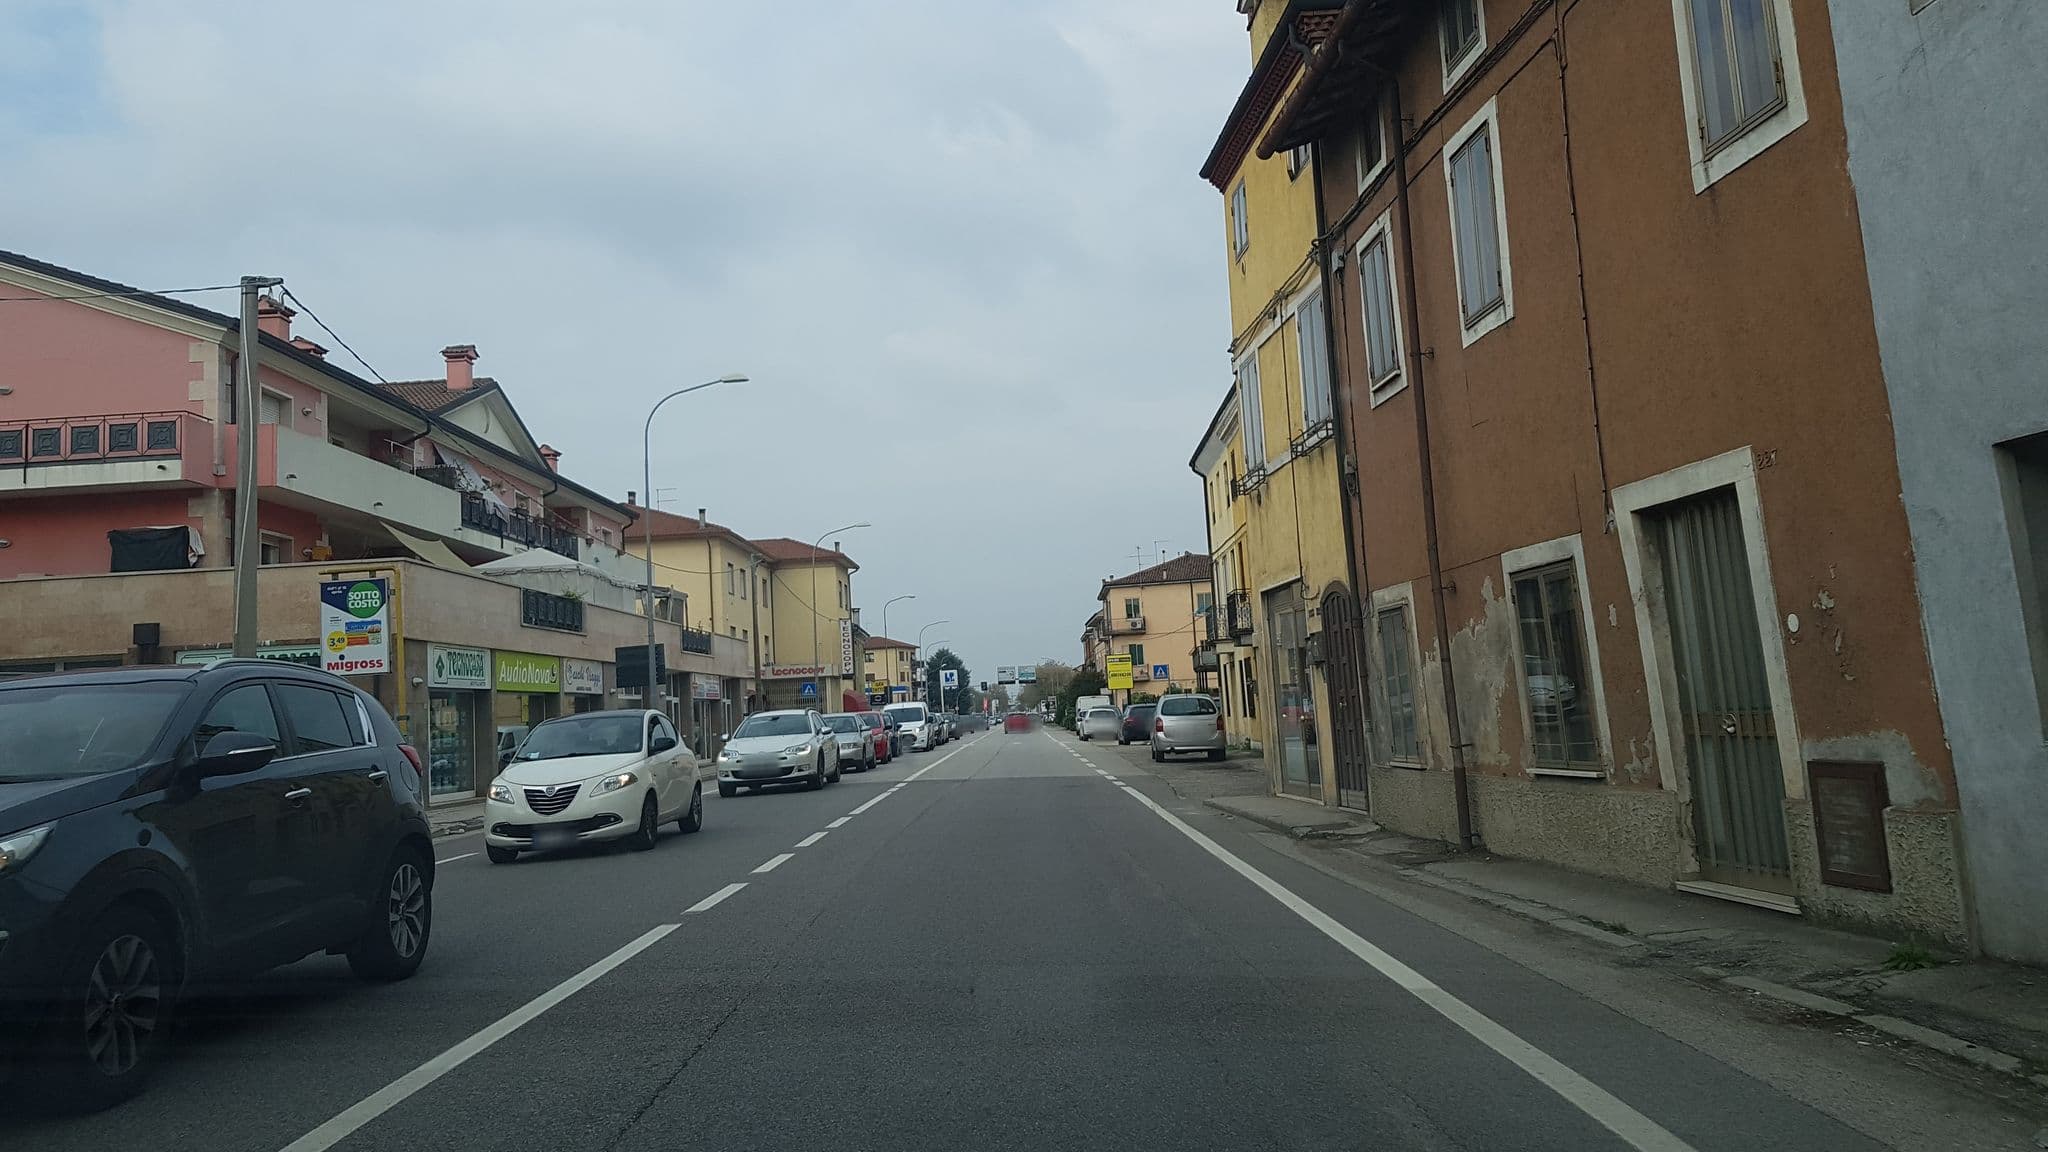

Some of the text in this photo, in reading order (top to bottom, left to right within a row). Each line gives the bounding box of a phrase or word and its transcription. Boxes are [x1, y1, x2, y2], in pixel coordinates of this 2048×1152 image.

[348, 590, 380, 601] SOTTO
[348, 599, 380, 609] COSTO
[842, 620, 851, 673] TECNOCOPY
[499, 661, 551, 685] AudioNova
